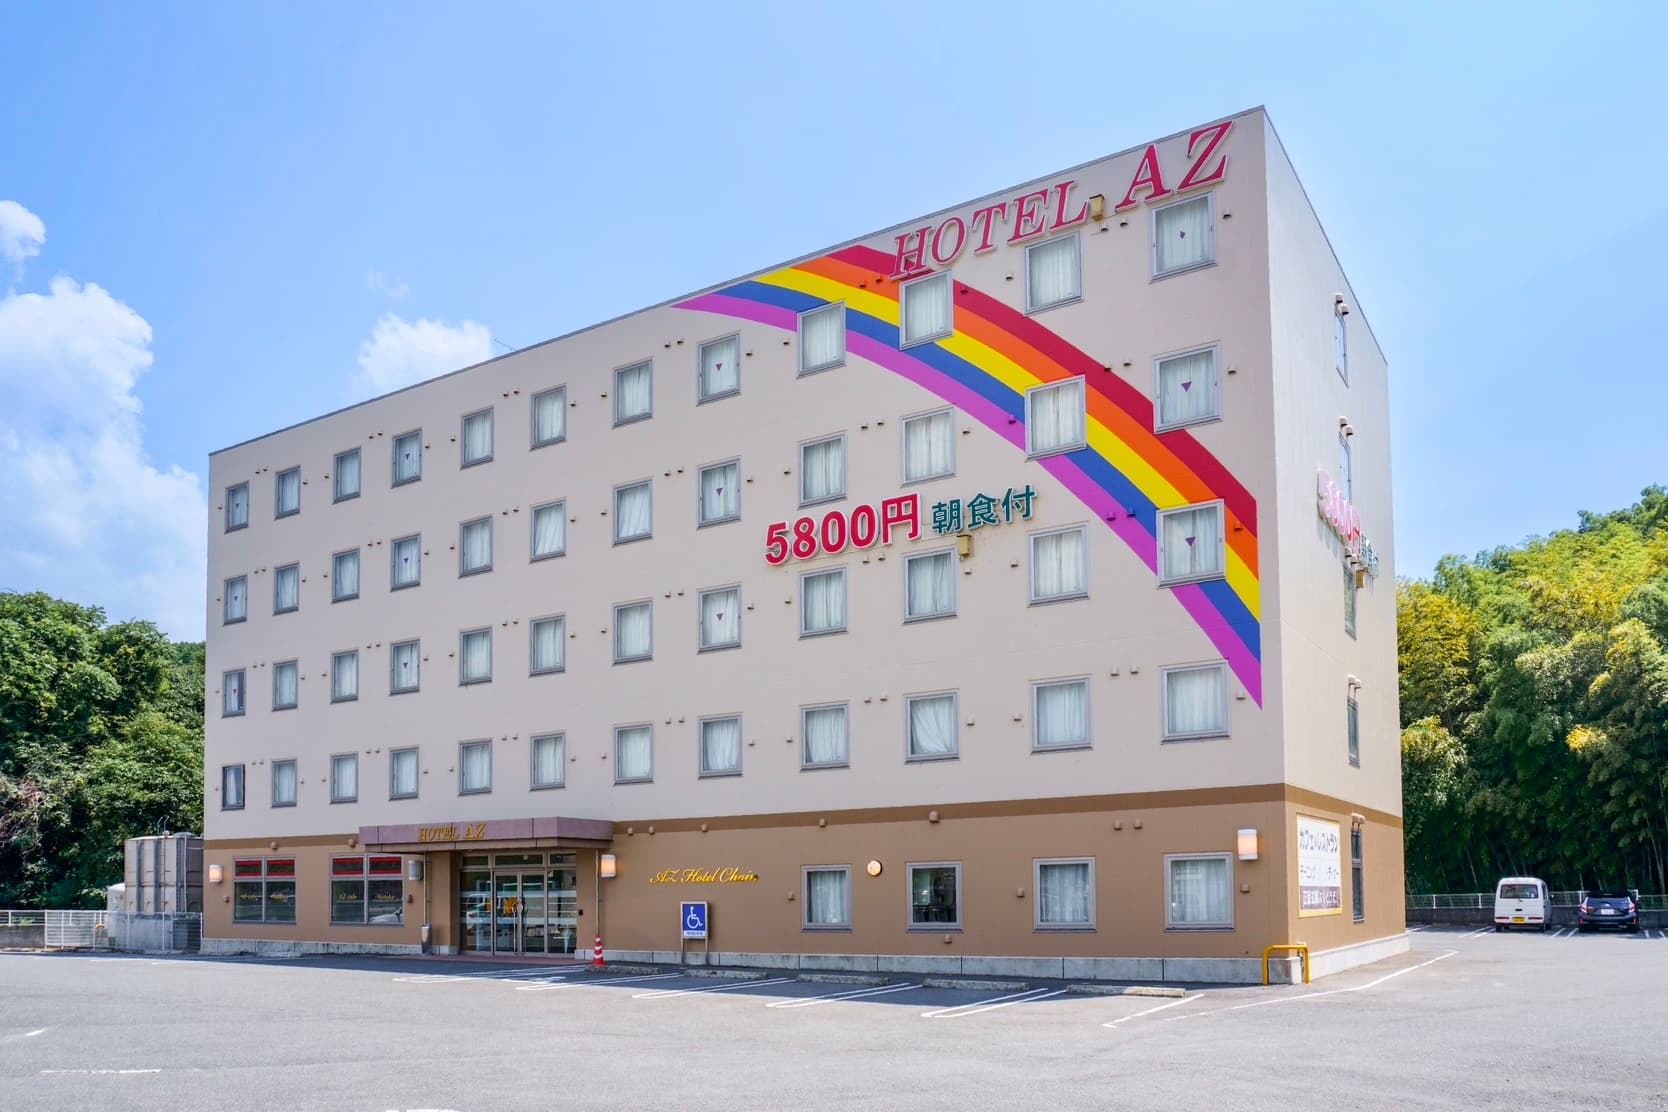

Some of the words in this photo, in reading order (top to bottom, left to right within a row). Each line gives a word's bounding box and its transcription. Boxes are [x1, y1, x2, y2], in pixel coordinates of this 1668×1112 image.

[888, 180, 1090, 281] HOTEL
[1113, 120, 1234, 213] AZ
[764, 492, 921, 566] 5800円
[931, 484, 1037, 535] 朝食付
[418, 825, 460, 841] HOTEL
[463, 822, 487, 840] AZ
[680, 866, 721, 883] Hotel
